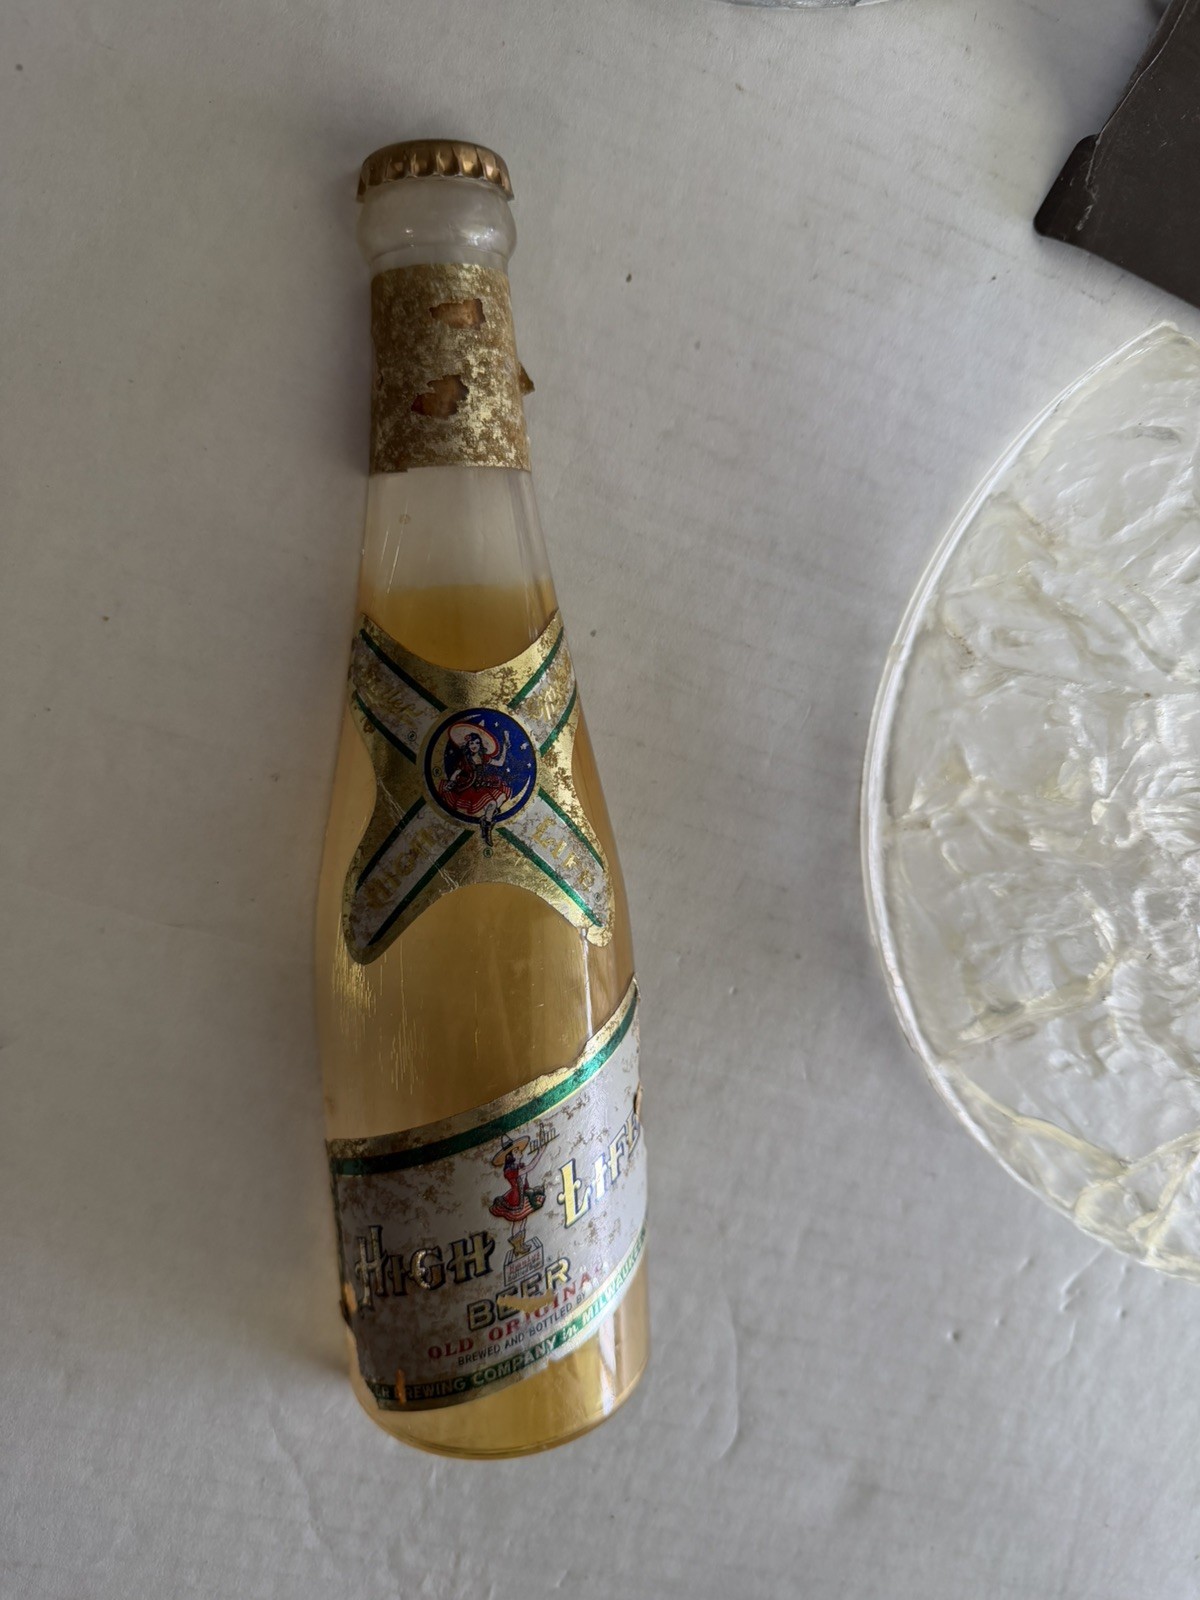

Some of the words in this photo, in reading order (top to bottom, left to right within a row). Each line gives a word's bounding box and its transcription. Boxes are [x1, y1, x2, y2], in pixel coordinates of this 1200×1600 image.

[467, 1257, 571, 1331] BEER
[427, 1337, 474, 1359] OLD
[457, 1345, 501, 1366] BREWED
[504, 1333, 525, 1349] AND
[529, 1302, 574, 1337] BOTTLED
[395, 1378, 467, 1399] REWING
[471, 1337, 557, 1387] COMPANY
